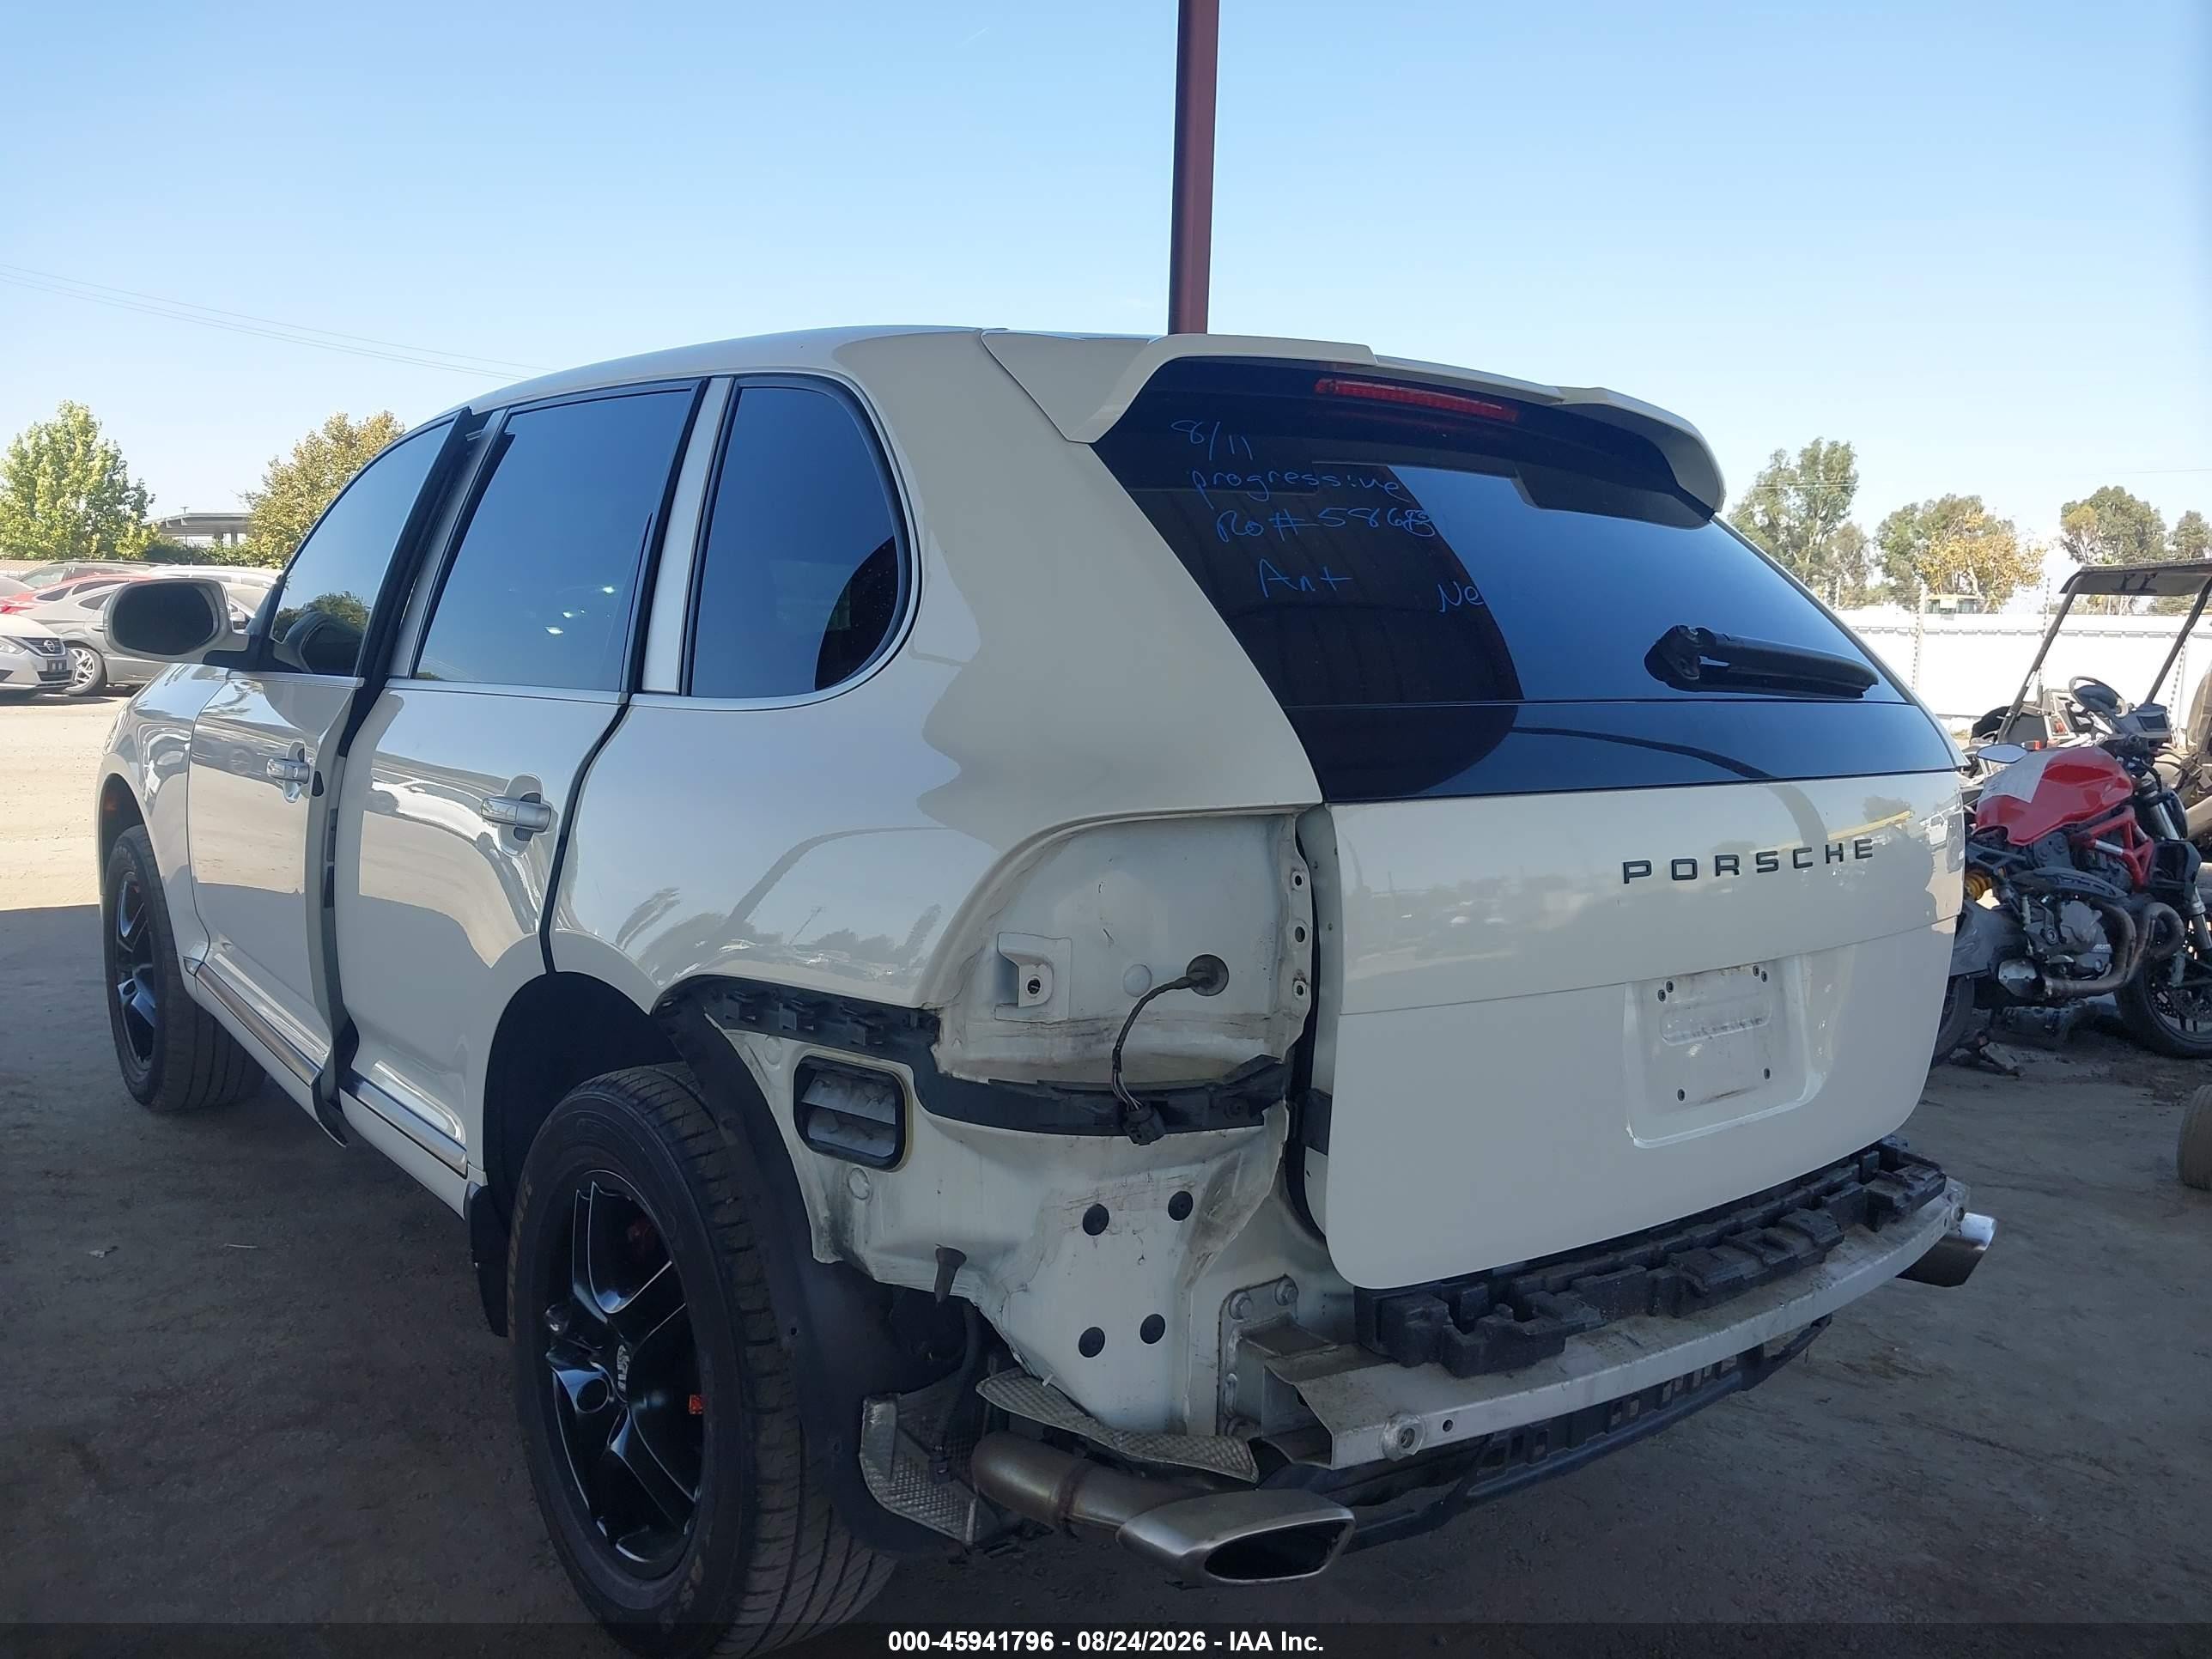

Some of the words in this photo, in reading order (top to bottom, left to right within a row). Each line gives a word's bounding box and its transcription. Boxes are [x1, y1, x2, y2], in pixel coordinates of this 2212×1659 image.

[1170, 419, 1254, 461] 8/11
[1191, 469, 1411, 509] progressive
[1623, 838, 1874, 884] PORSCHE
